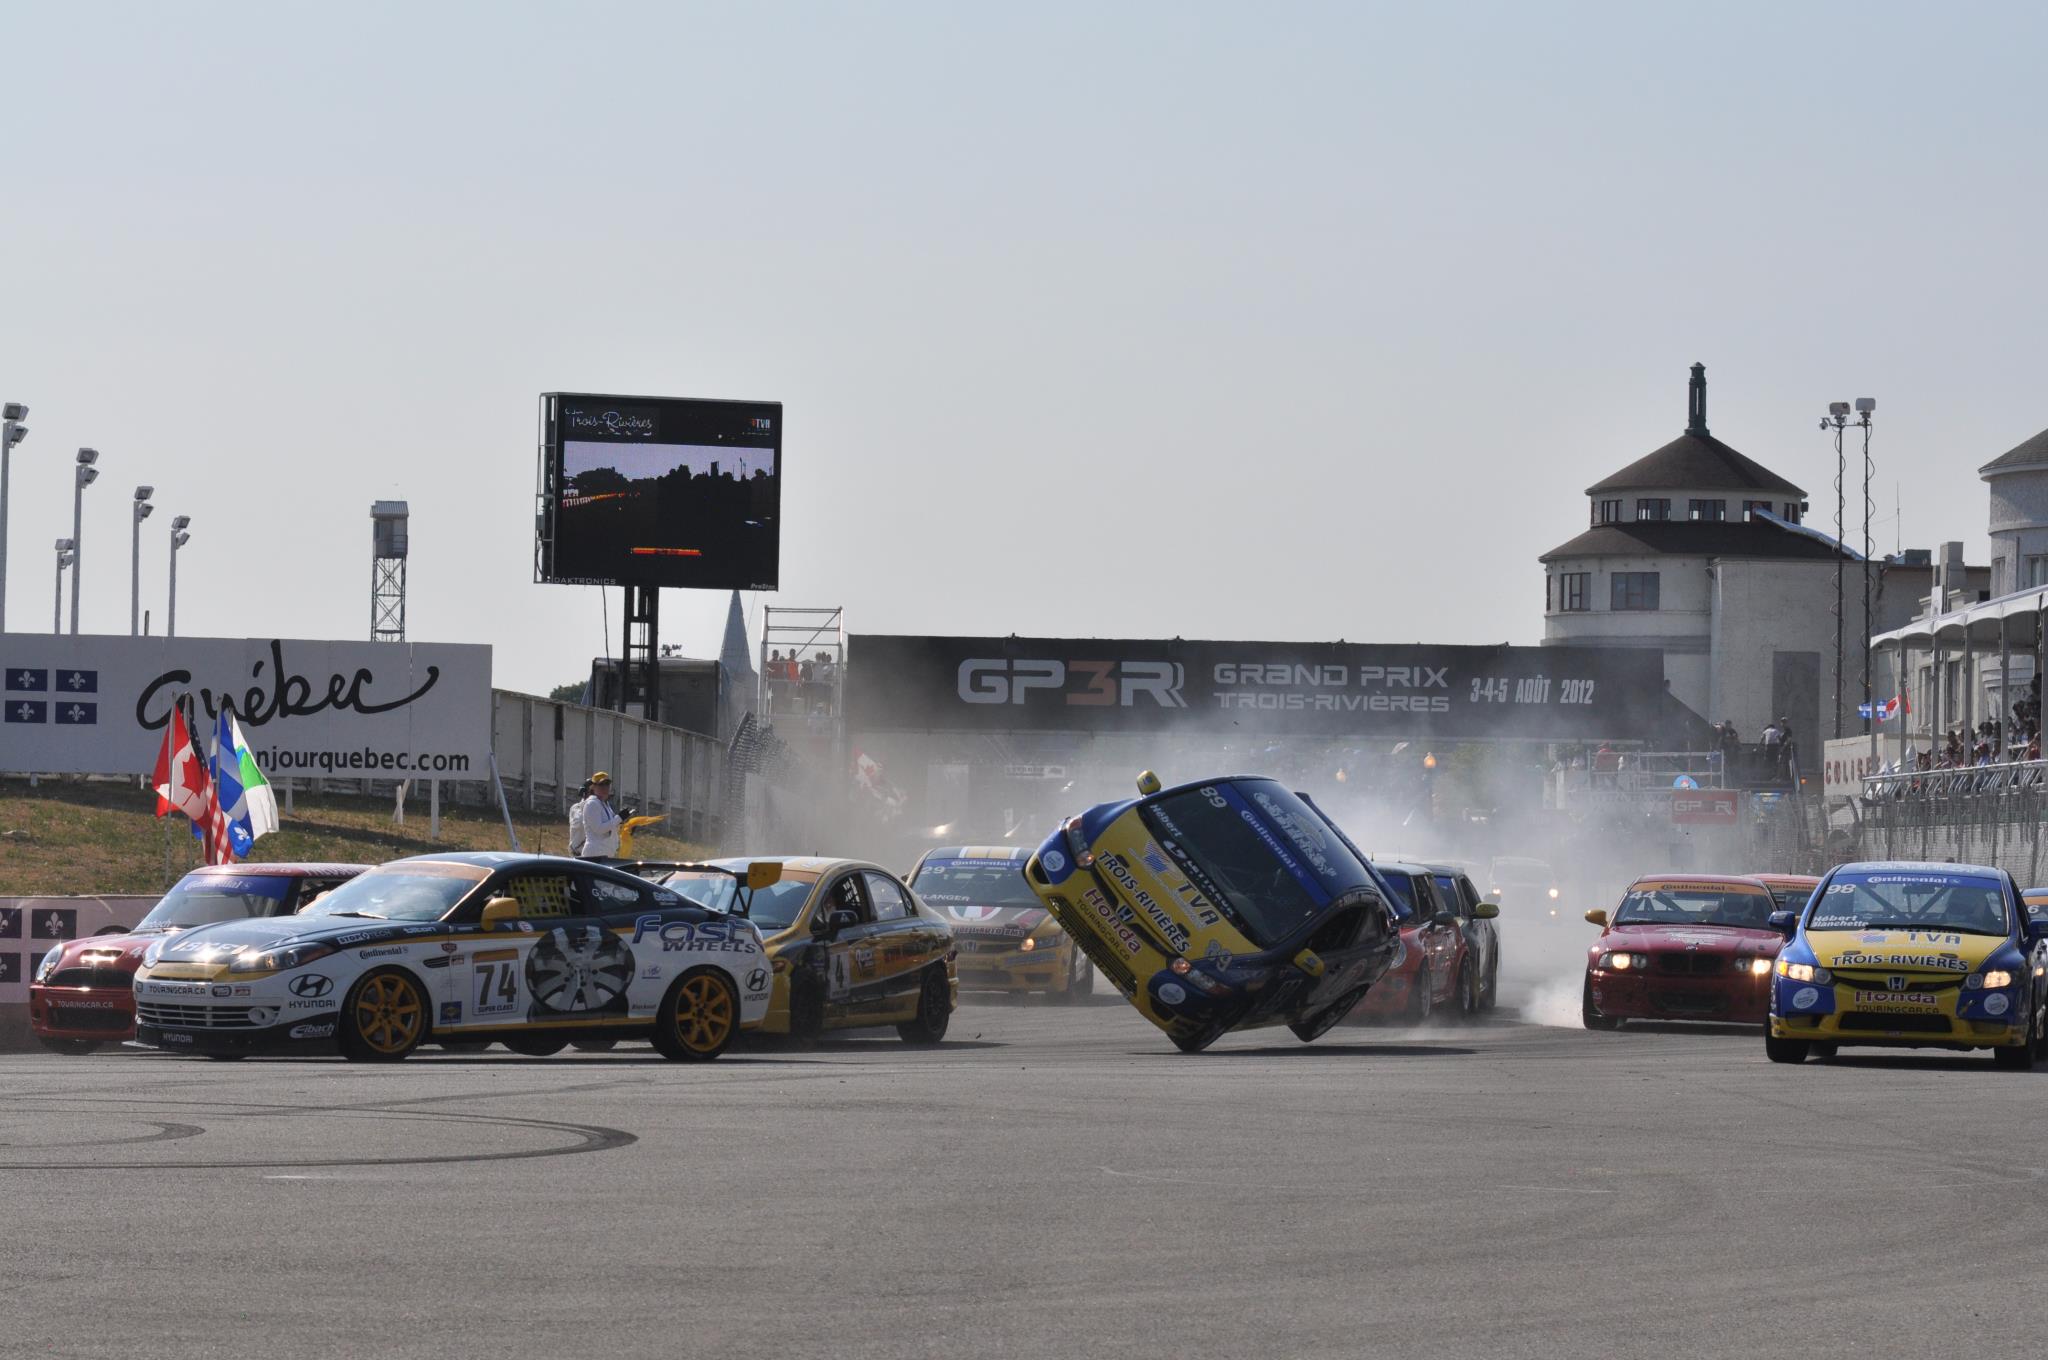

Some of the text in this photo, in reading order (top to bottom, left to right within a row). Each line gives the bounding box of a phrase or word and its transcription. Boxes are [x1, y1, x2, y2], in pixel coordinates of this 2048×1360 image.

[554, 576, 617, 586] DAKTRONICS
[136, 639, 440, 730] Québec
[957, 658, 1190, 708] GP3R
[1360, 665, 1449, 688] PRIX
[1470, 674, 1595, 705] 3-4-5 AOÛT 2012
[1200, 785, 1228, 809] 89
[1240, 809, 1297, 870] Continental
[920, 866, 946, 875] 29
[1867, 876, 1947, 884] Continental
[1630, 890, 1657, 900] 44
[1826, 884, 1857, 895] 98
[1098, 850, 1191, 955] TROIS-RIVIÈRES
[1177, 879, 1221, 926] TVA
[1084, 888, 1142, 954] Honda
[1908, 932, 1961, 945] TVA
[359, 946, 403, 960] Continental
[662, 940, 757, 954] WHEELS
[1831, 954, 1969, 972] TROIS-RIVIÈRES
[475, 963, 517, 1006] 74
[289, 1000, 336, 1009] HYUNDAI
[1855, 991, 1937, 1004] Honda
[163, 1032, 193, 1044] HYUNDAI
